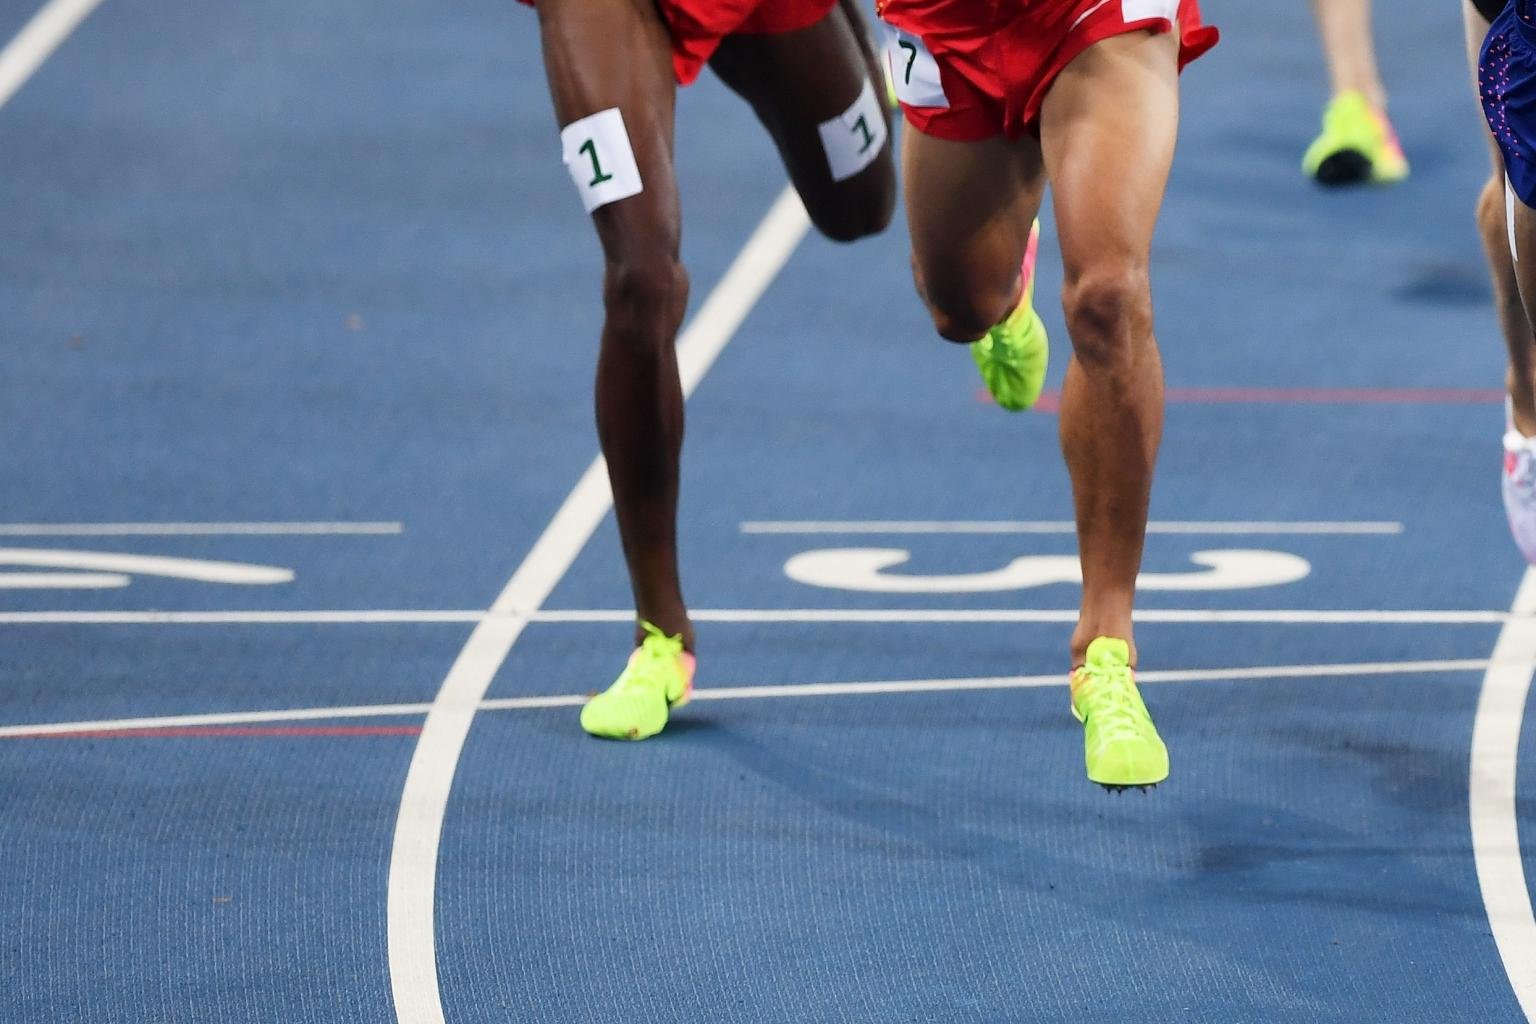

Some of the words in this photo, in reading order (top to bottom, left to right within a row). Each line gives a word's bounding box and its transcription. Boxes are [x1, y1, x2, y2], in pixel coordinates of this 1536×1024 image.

[898, 38, 917, 85] 7
[850, 112, 876, 155] 1
[578, 138, 613, 188] 1
